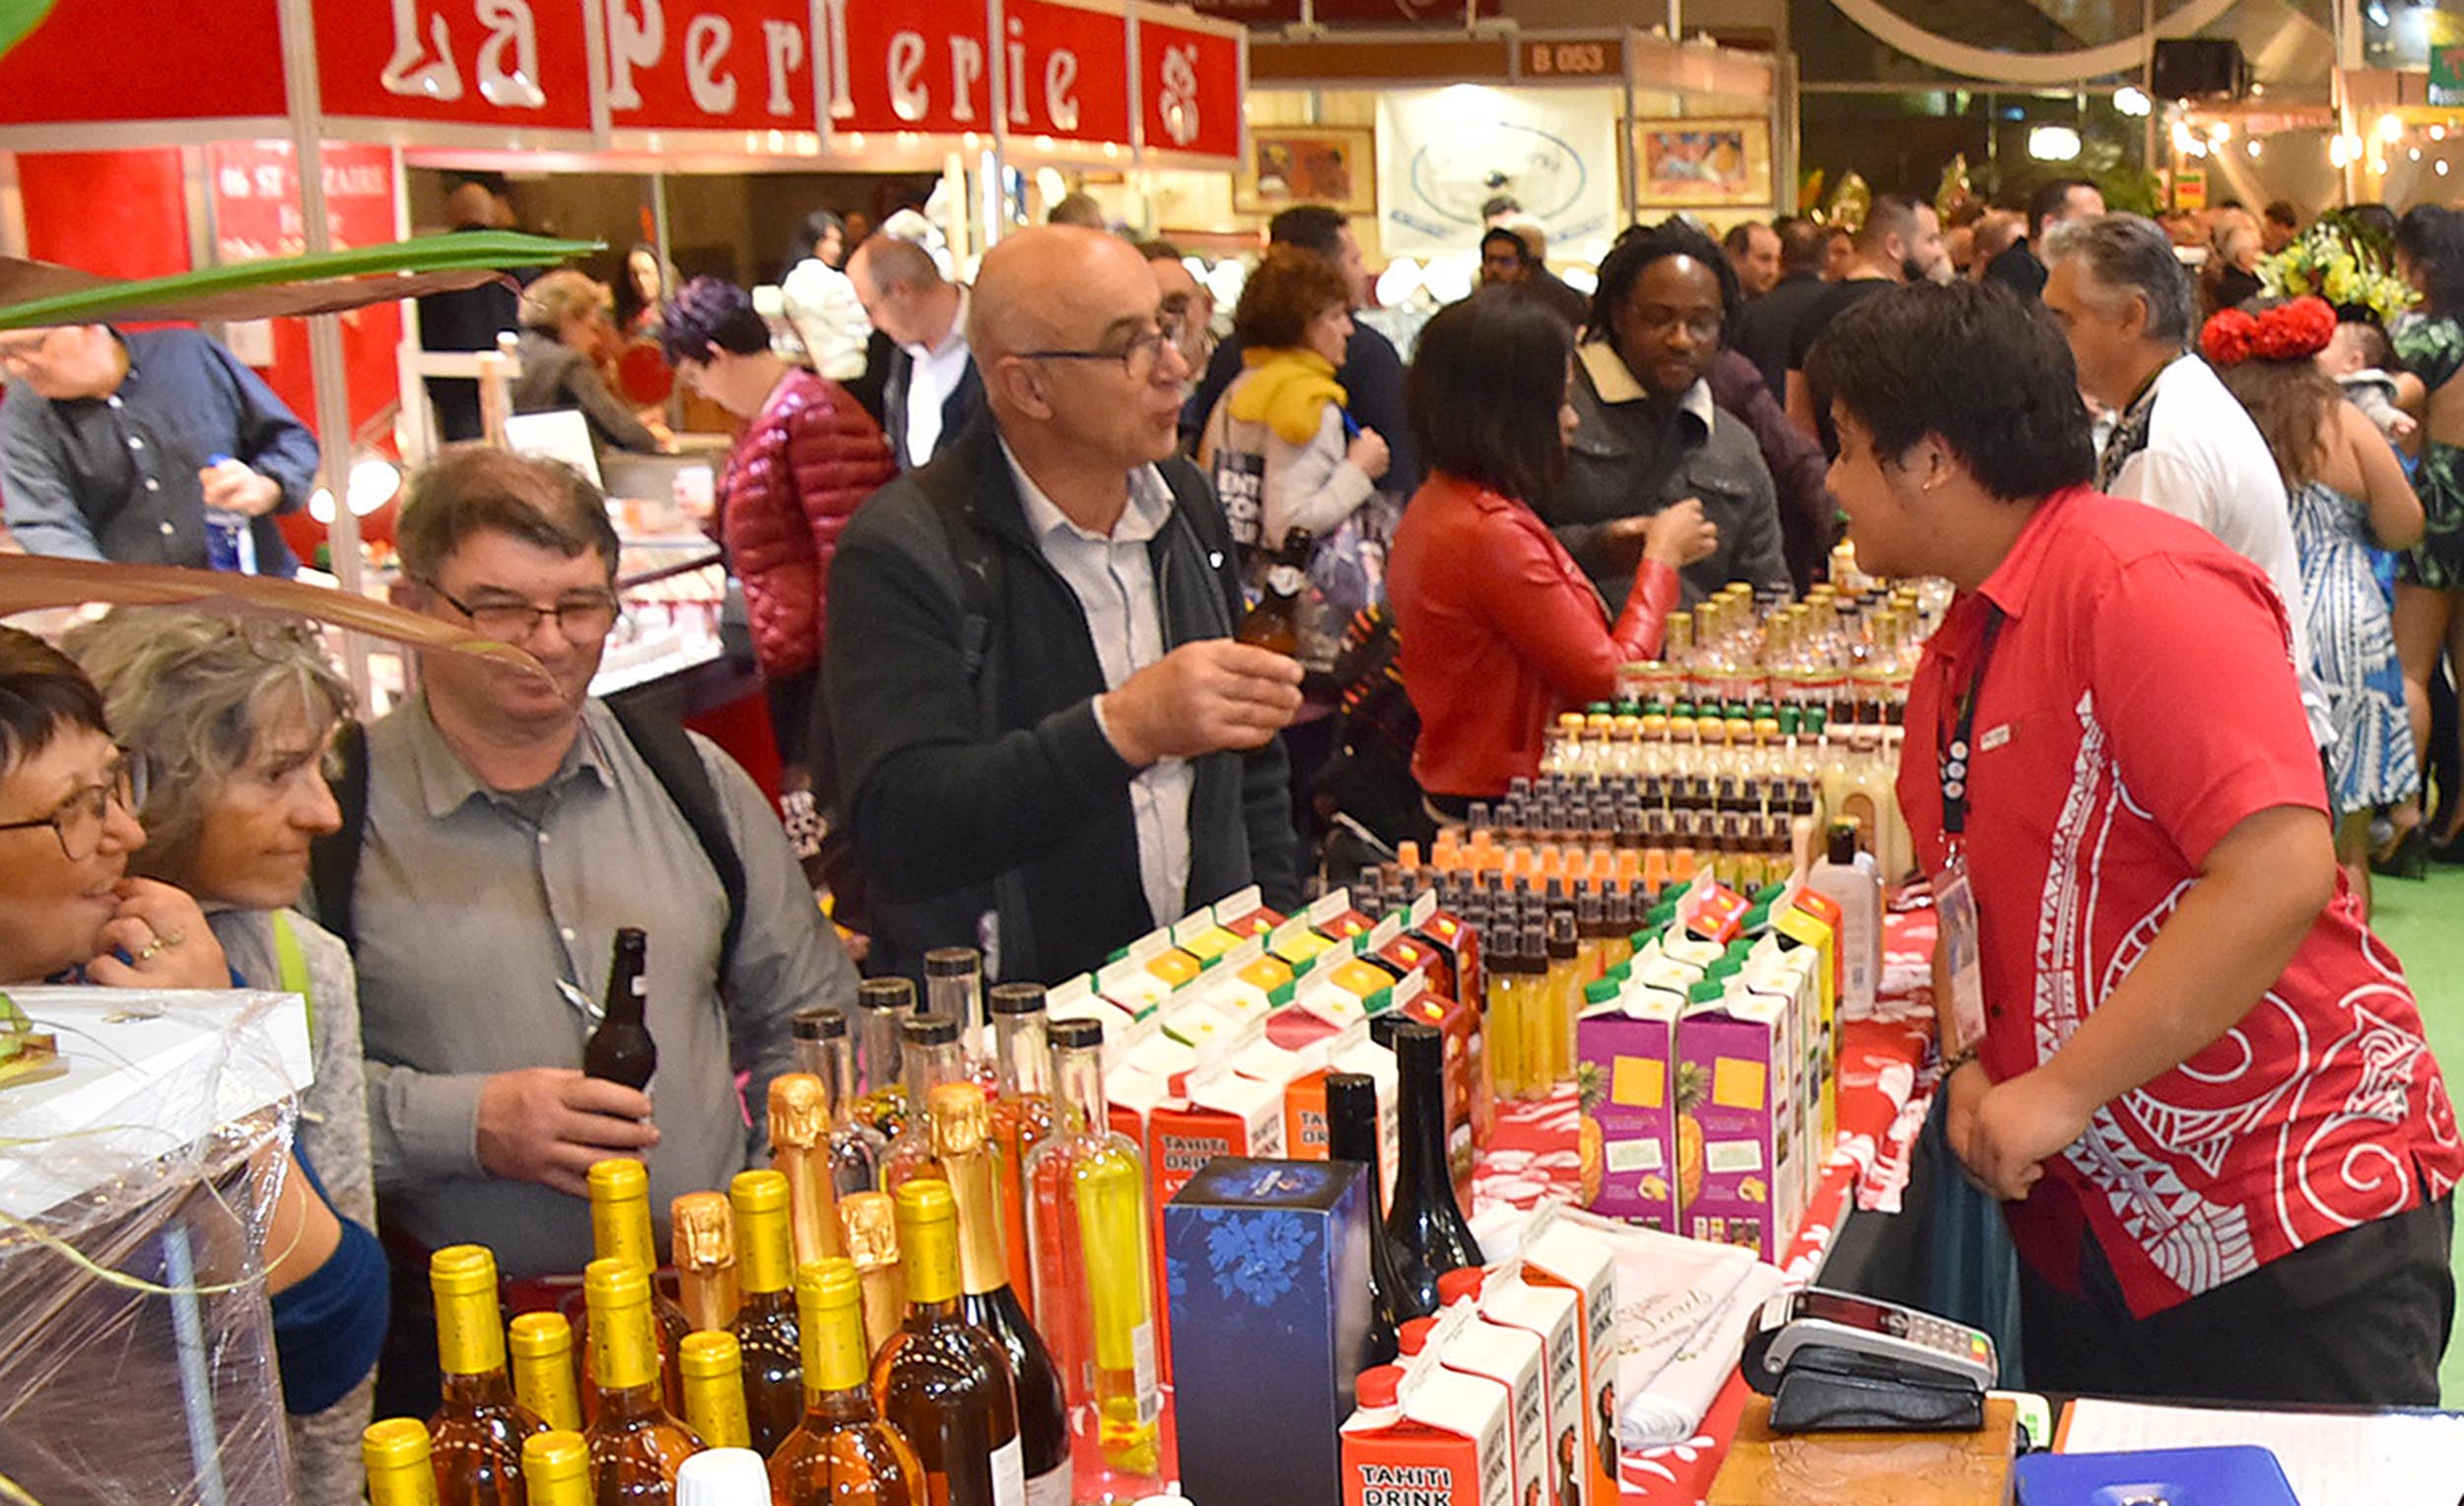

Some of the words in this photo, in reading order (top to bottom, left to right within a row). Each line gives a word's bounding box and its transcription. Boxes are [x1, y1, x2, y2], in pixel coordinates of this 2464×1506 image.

[380, 0, 546, 109] La
[608, 0, 1079, 131] Perlerie
[1160, 1134, 1229, 1156] TAHITI
[1164, 1150, 1211, 1172] DRI
[1357, 1465, 1452, 1487] TAHITI
[1361, 1485, 1453, 1506] DRINK
